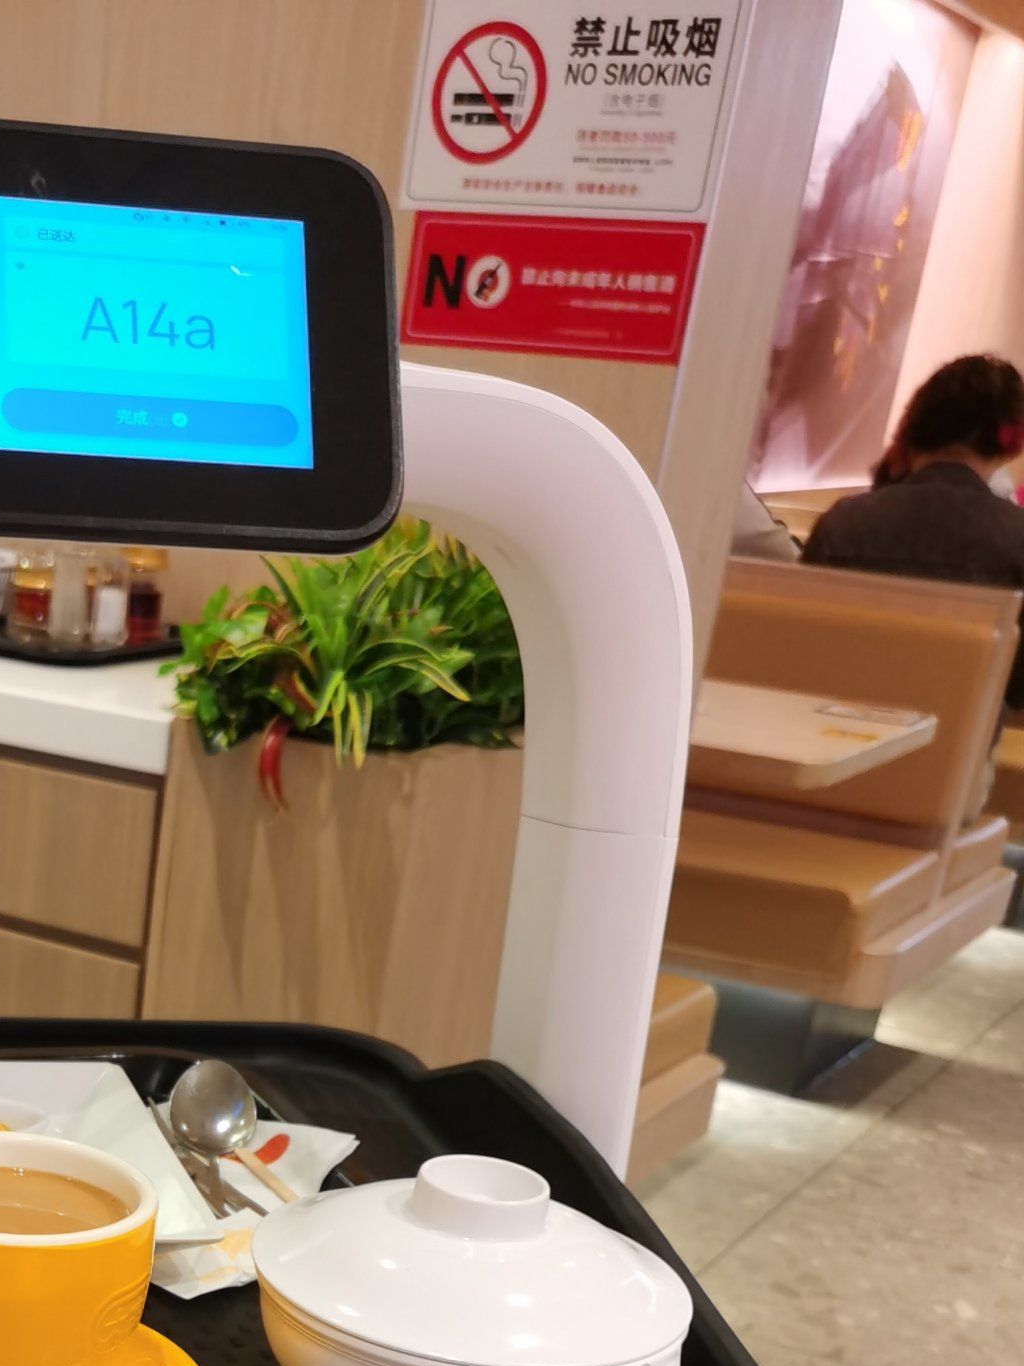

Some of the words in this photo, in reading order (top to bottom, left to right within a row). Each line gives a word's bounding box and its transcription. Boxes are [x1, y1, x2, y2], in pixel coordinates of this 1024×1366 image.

[569, 16, 722, 59] 禁止吸烟
[564, 62, 597, 86] NO
[603, 62, 713, 87] SMOKING
[80, 295, 217, 352] A14a
